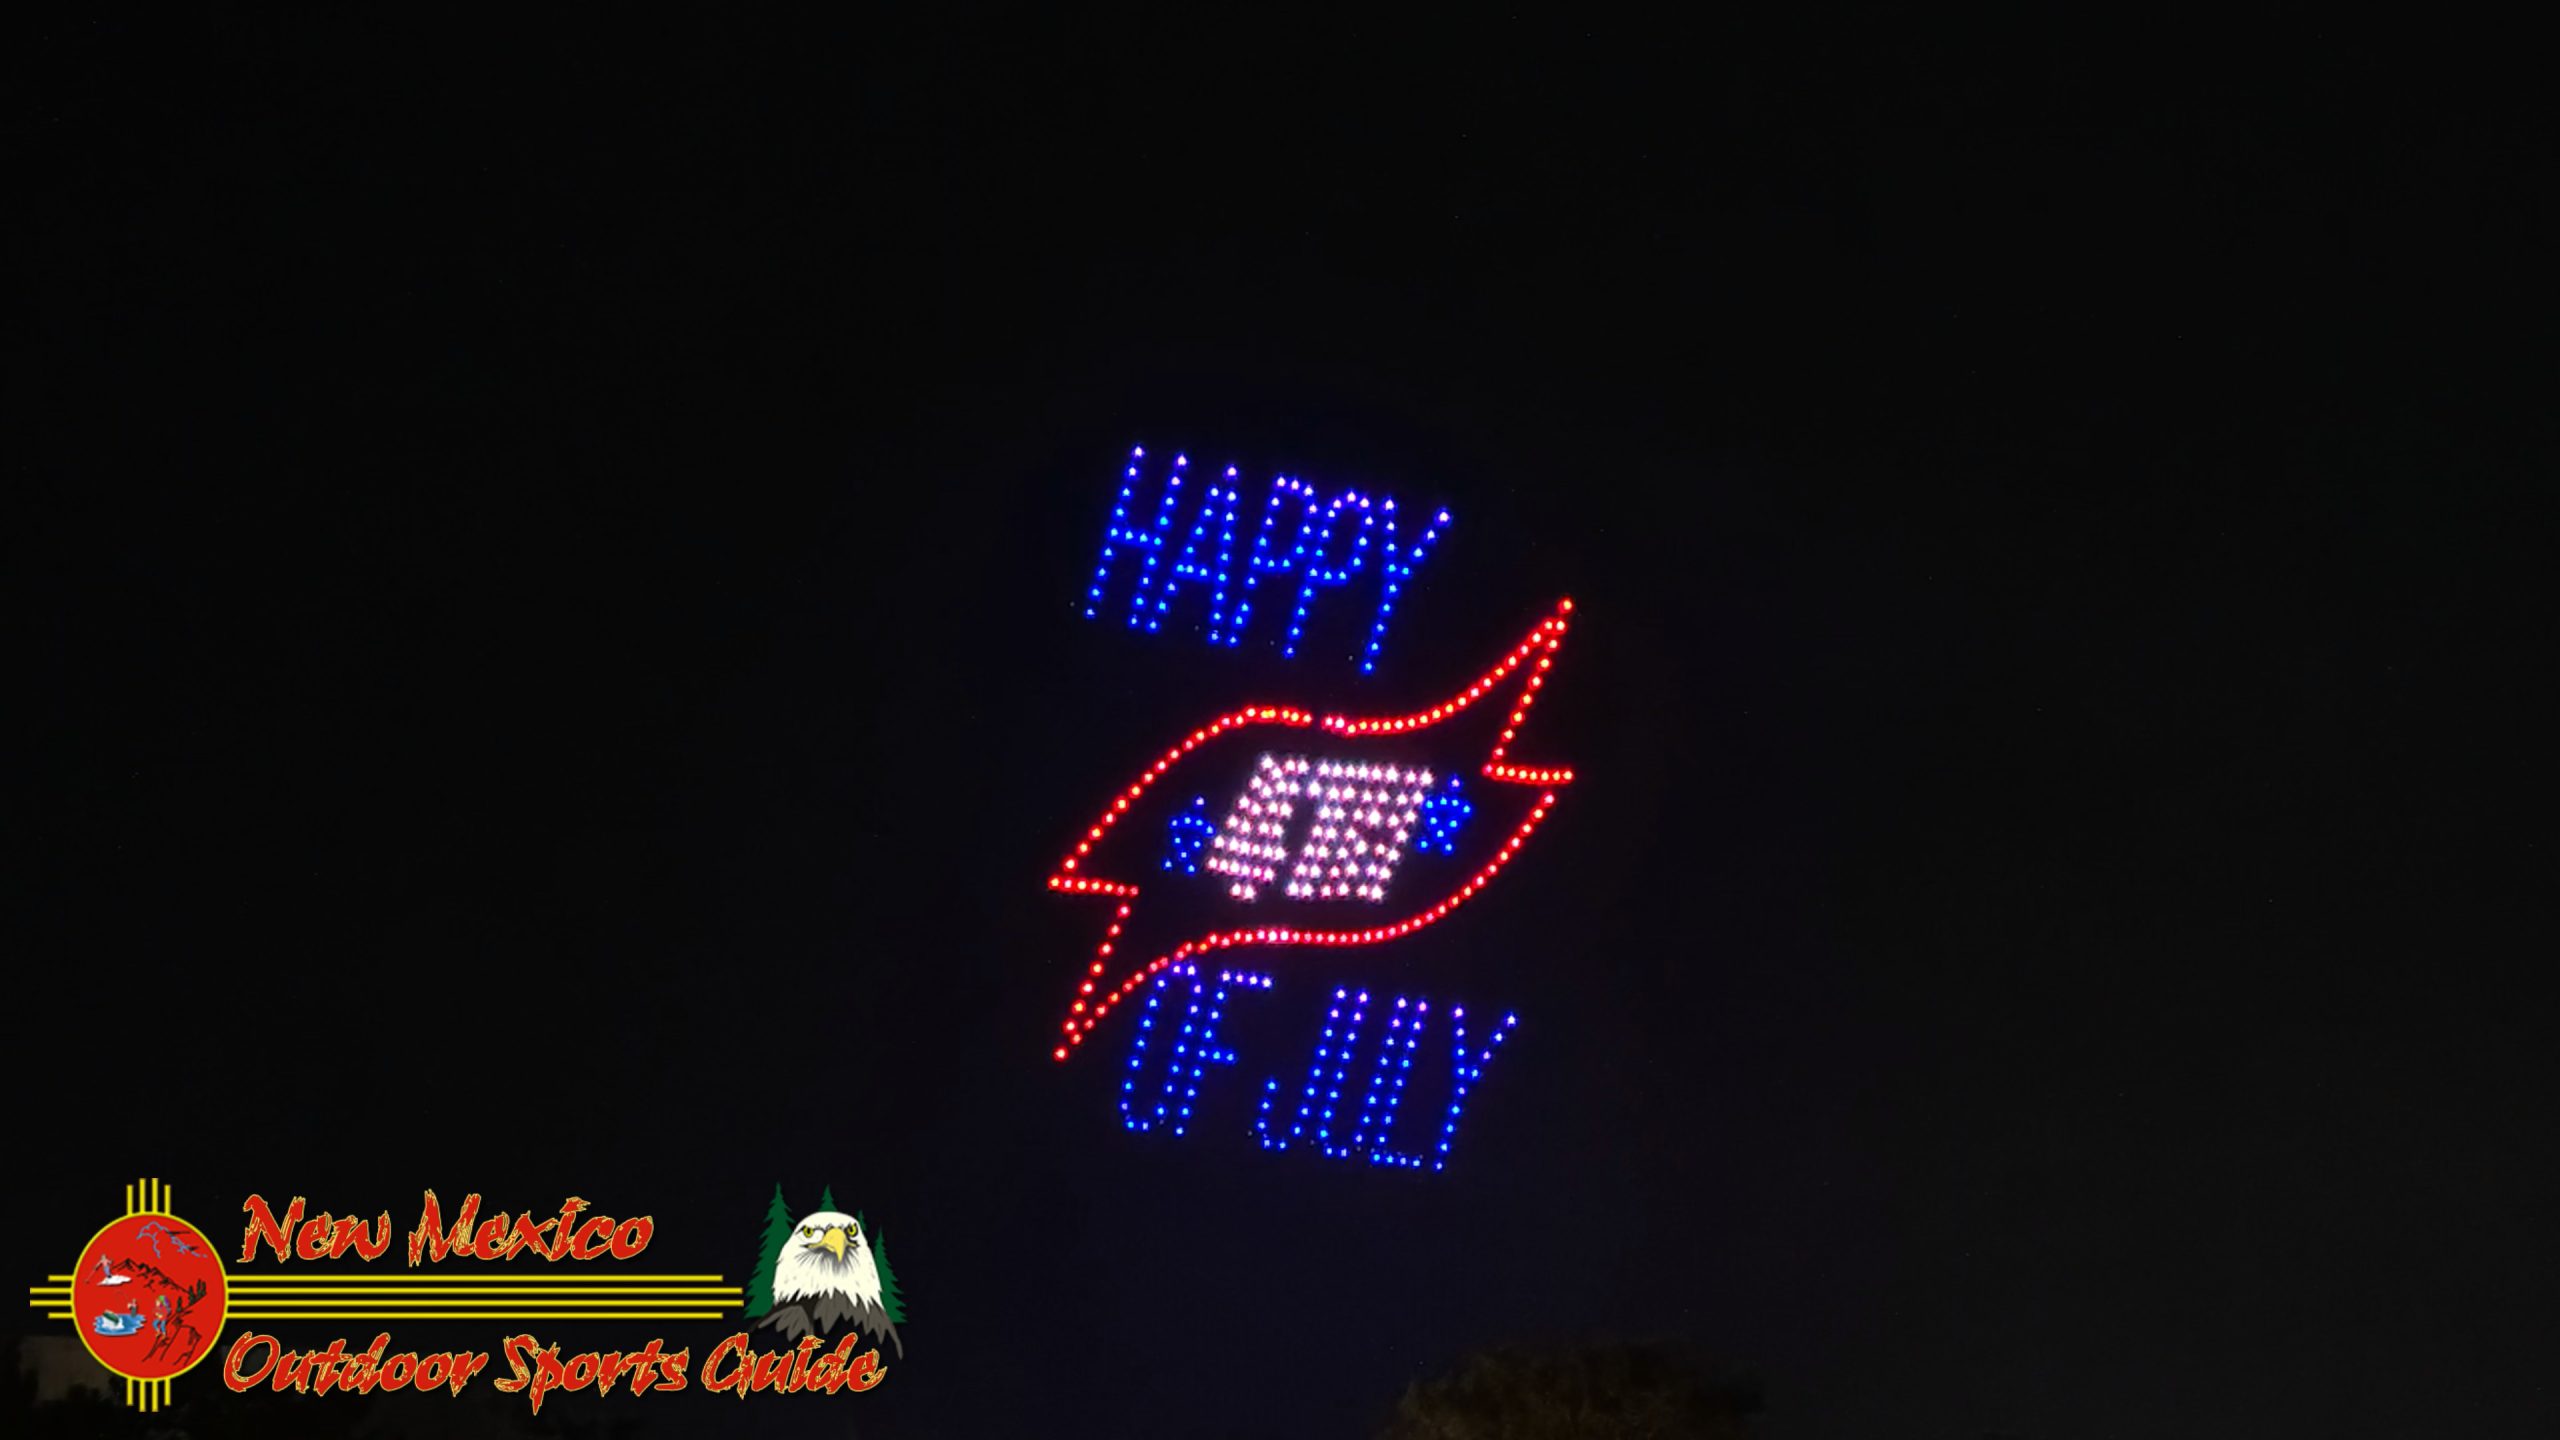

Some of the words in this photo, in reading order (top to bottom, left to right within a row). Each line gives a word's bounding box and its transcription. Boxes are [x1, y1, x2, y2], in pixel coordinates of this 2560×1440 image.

[1085, 445, 1451, 673] HAPPY
[1119, 962, 1275, 1136] OF
[1256, 987, 1519, 1172] JULY
